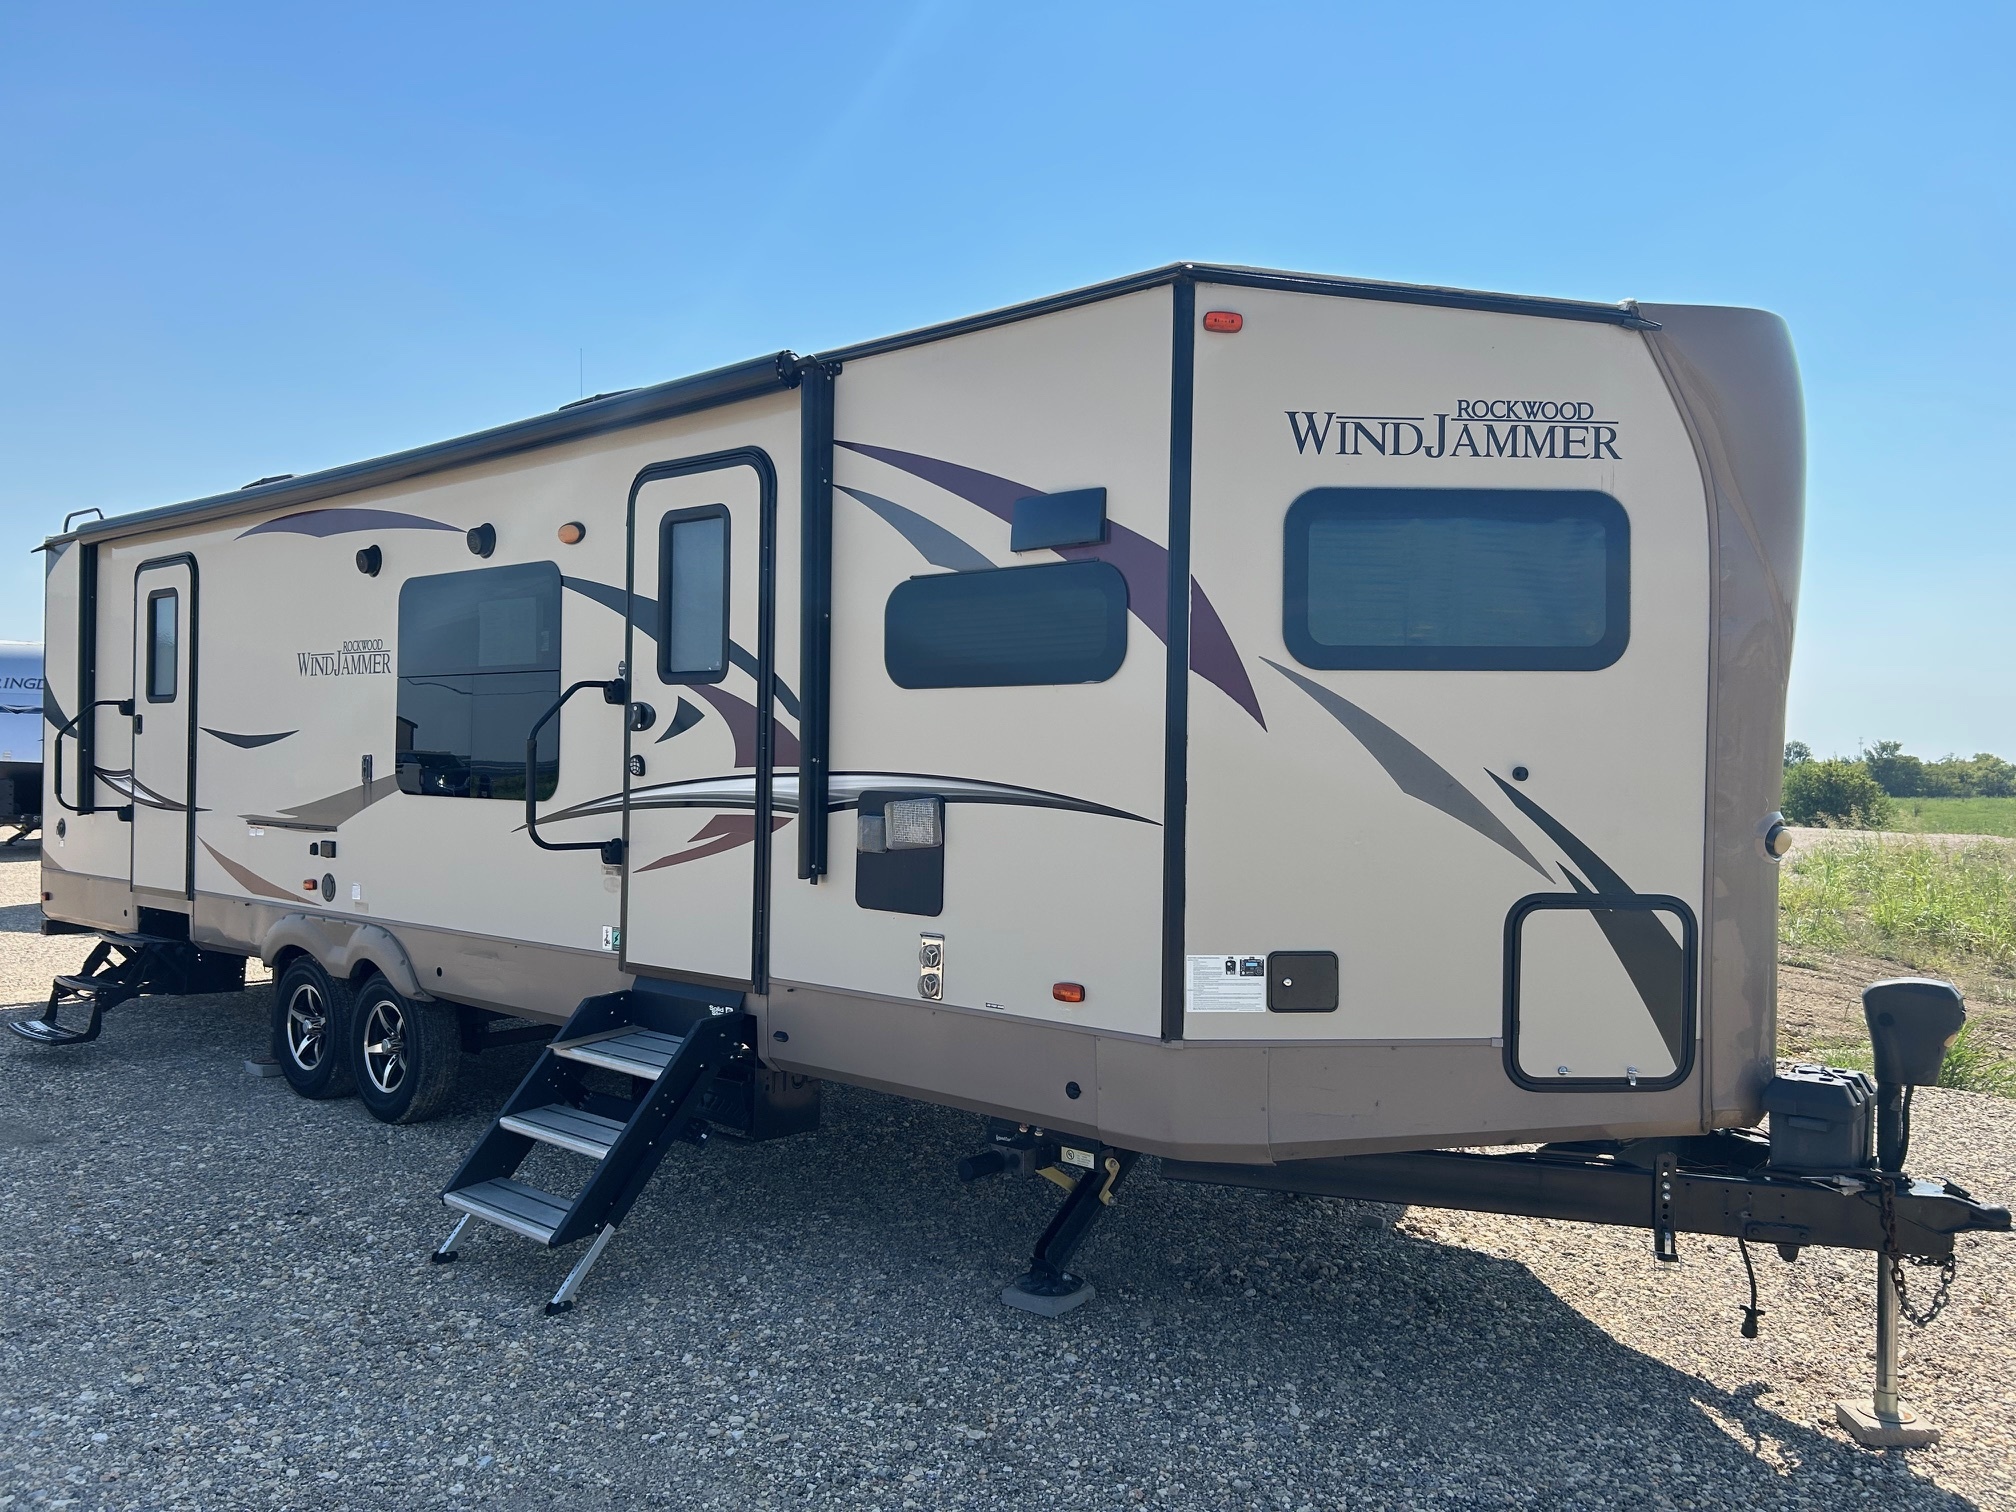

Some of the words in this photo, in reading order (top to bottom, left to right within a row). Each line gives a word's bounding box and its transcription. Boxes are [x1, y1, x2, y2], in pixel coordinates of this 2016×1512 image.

[1456, 399, 1594, 420] ROCKWOOD
[1284, 410, 1623, 460] WINDJAMMER
[343, 639, 383, 651] ROCKWOOD
[297, 650, 391, 676] WINDJAMMER
[0, 677, 45, 690] INGD
